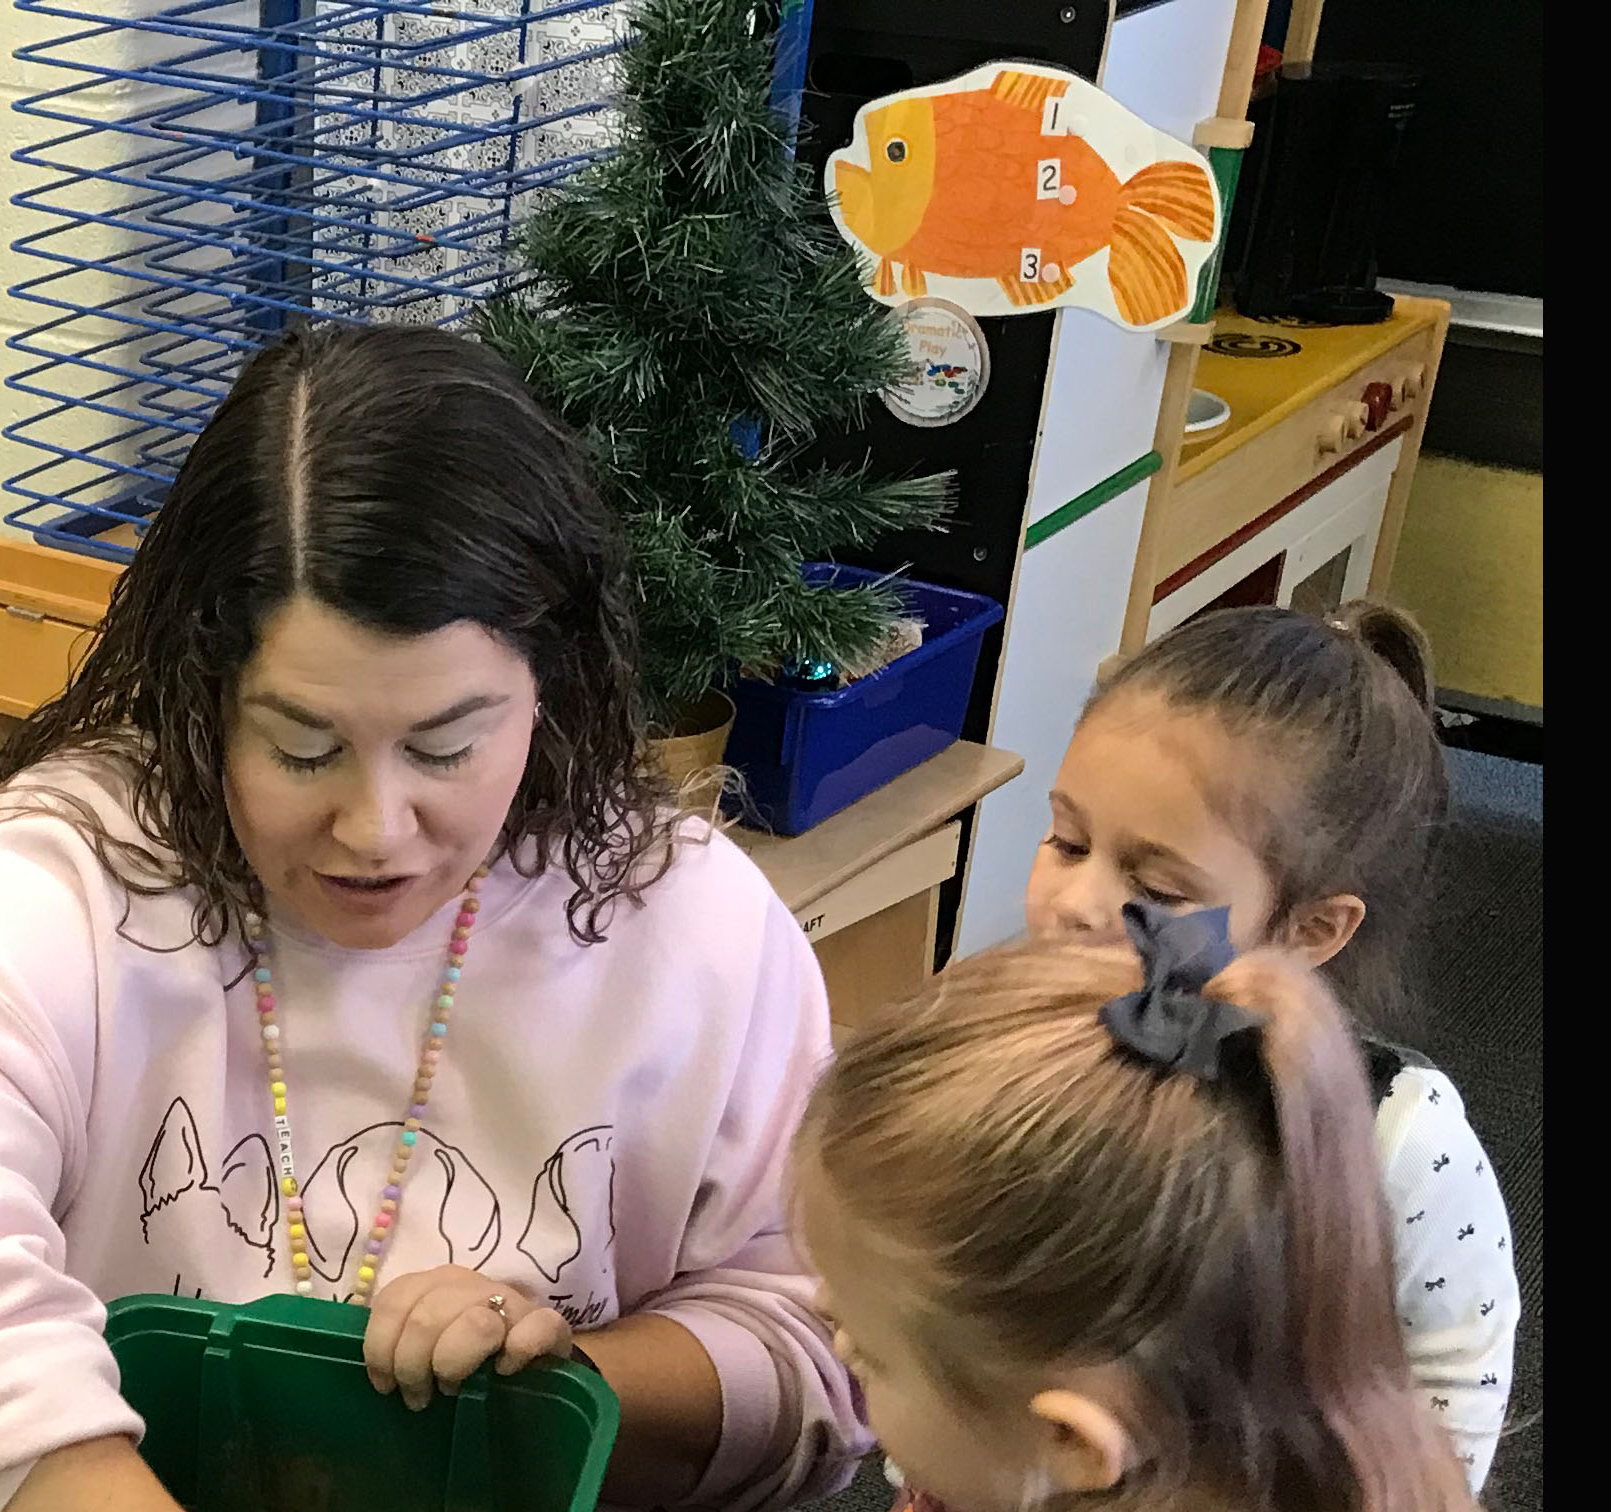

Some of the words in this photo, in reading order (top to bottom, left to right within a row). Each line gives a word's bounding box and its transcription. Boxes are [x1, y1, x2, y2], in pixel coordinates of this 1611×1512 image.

[1050, 101, 1059, 131] 1
[1041, 164, 1058, 192] 2
[1022, 253, 1039, 281] 3
[919, 339, 948, 359] Play
[803, 912, 826, 933] AFT
[275, 1118, 293, 1177] TEACH
